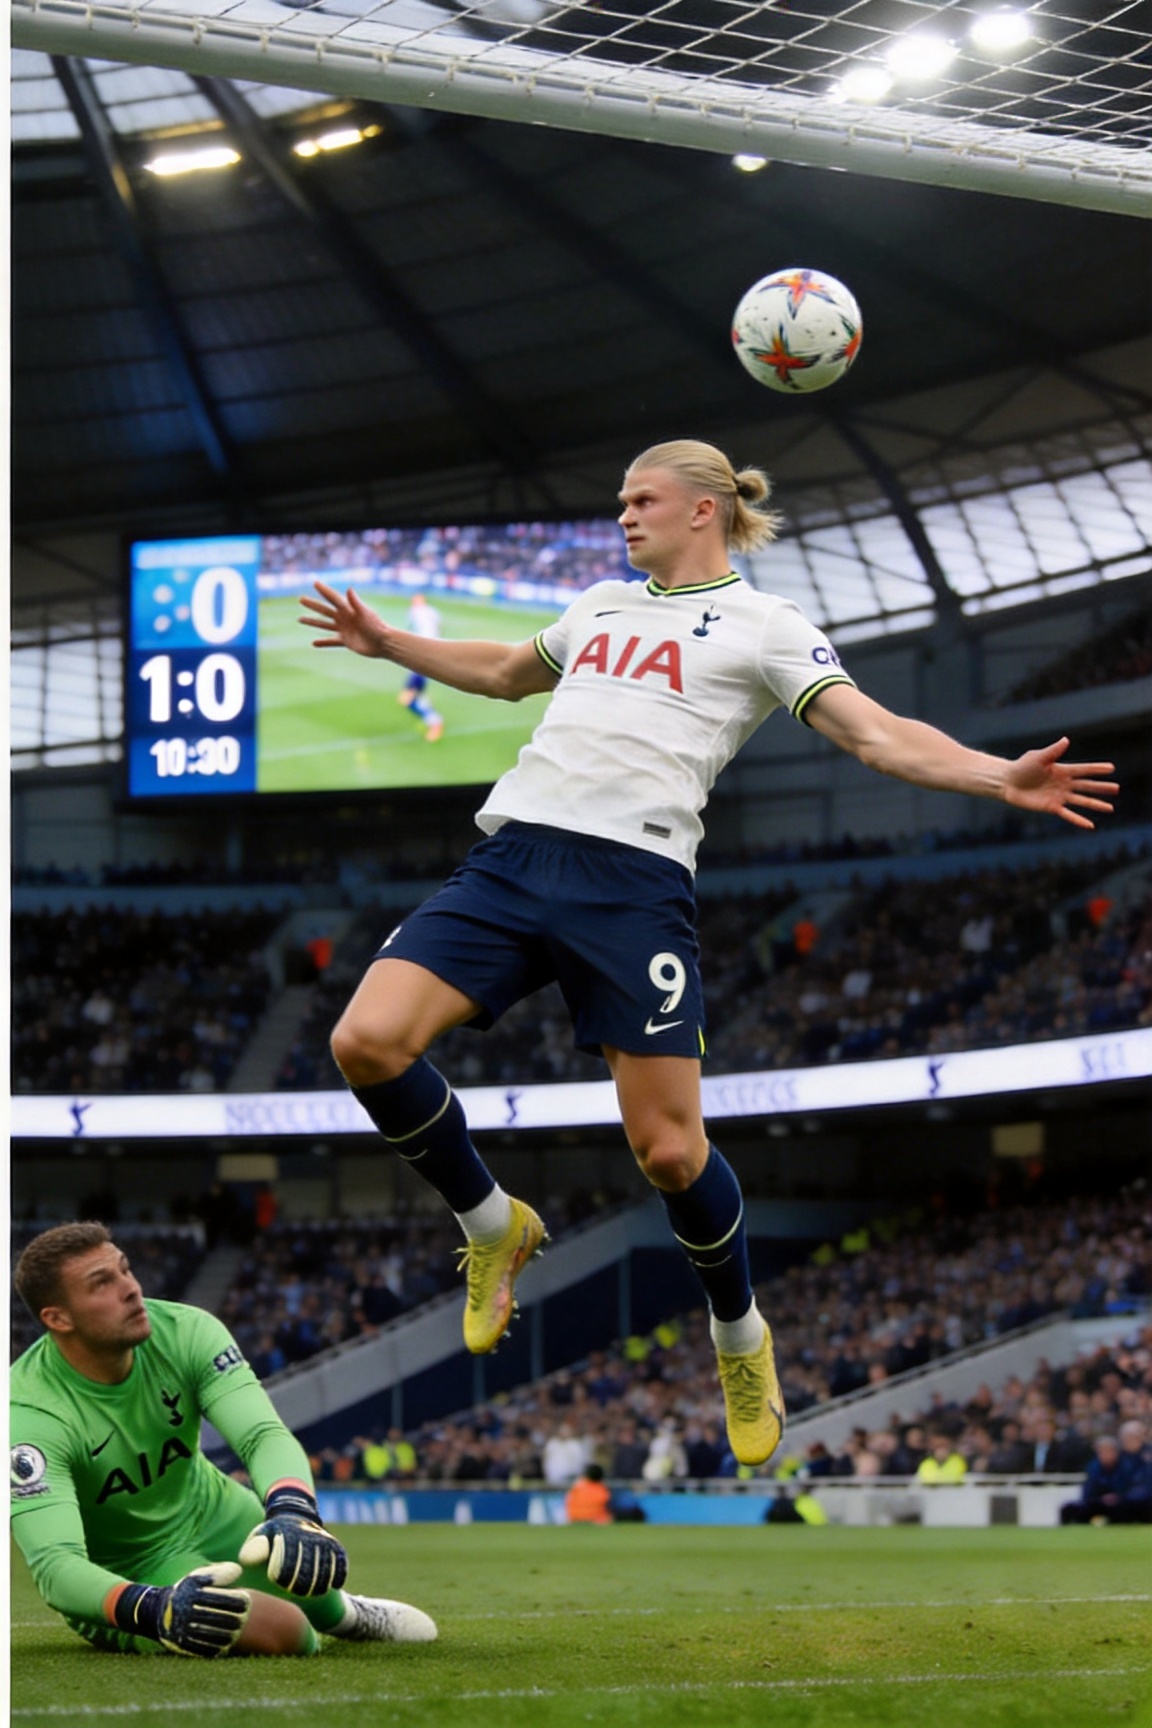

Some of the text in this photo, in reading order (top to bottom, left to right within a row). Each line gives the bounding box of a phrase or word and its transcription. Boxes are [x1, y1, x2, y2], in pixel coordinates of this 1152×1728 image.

[191, 565, 248, 643] 0
[139, 652, 246, 722] 1:0
[569, 632, 683, 694] AIA
[649, 952, 686, 1013] 9
[96, 1438, 192, 1504] AIA
